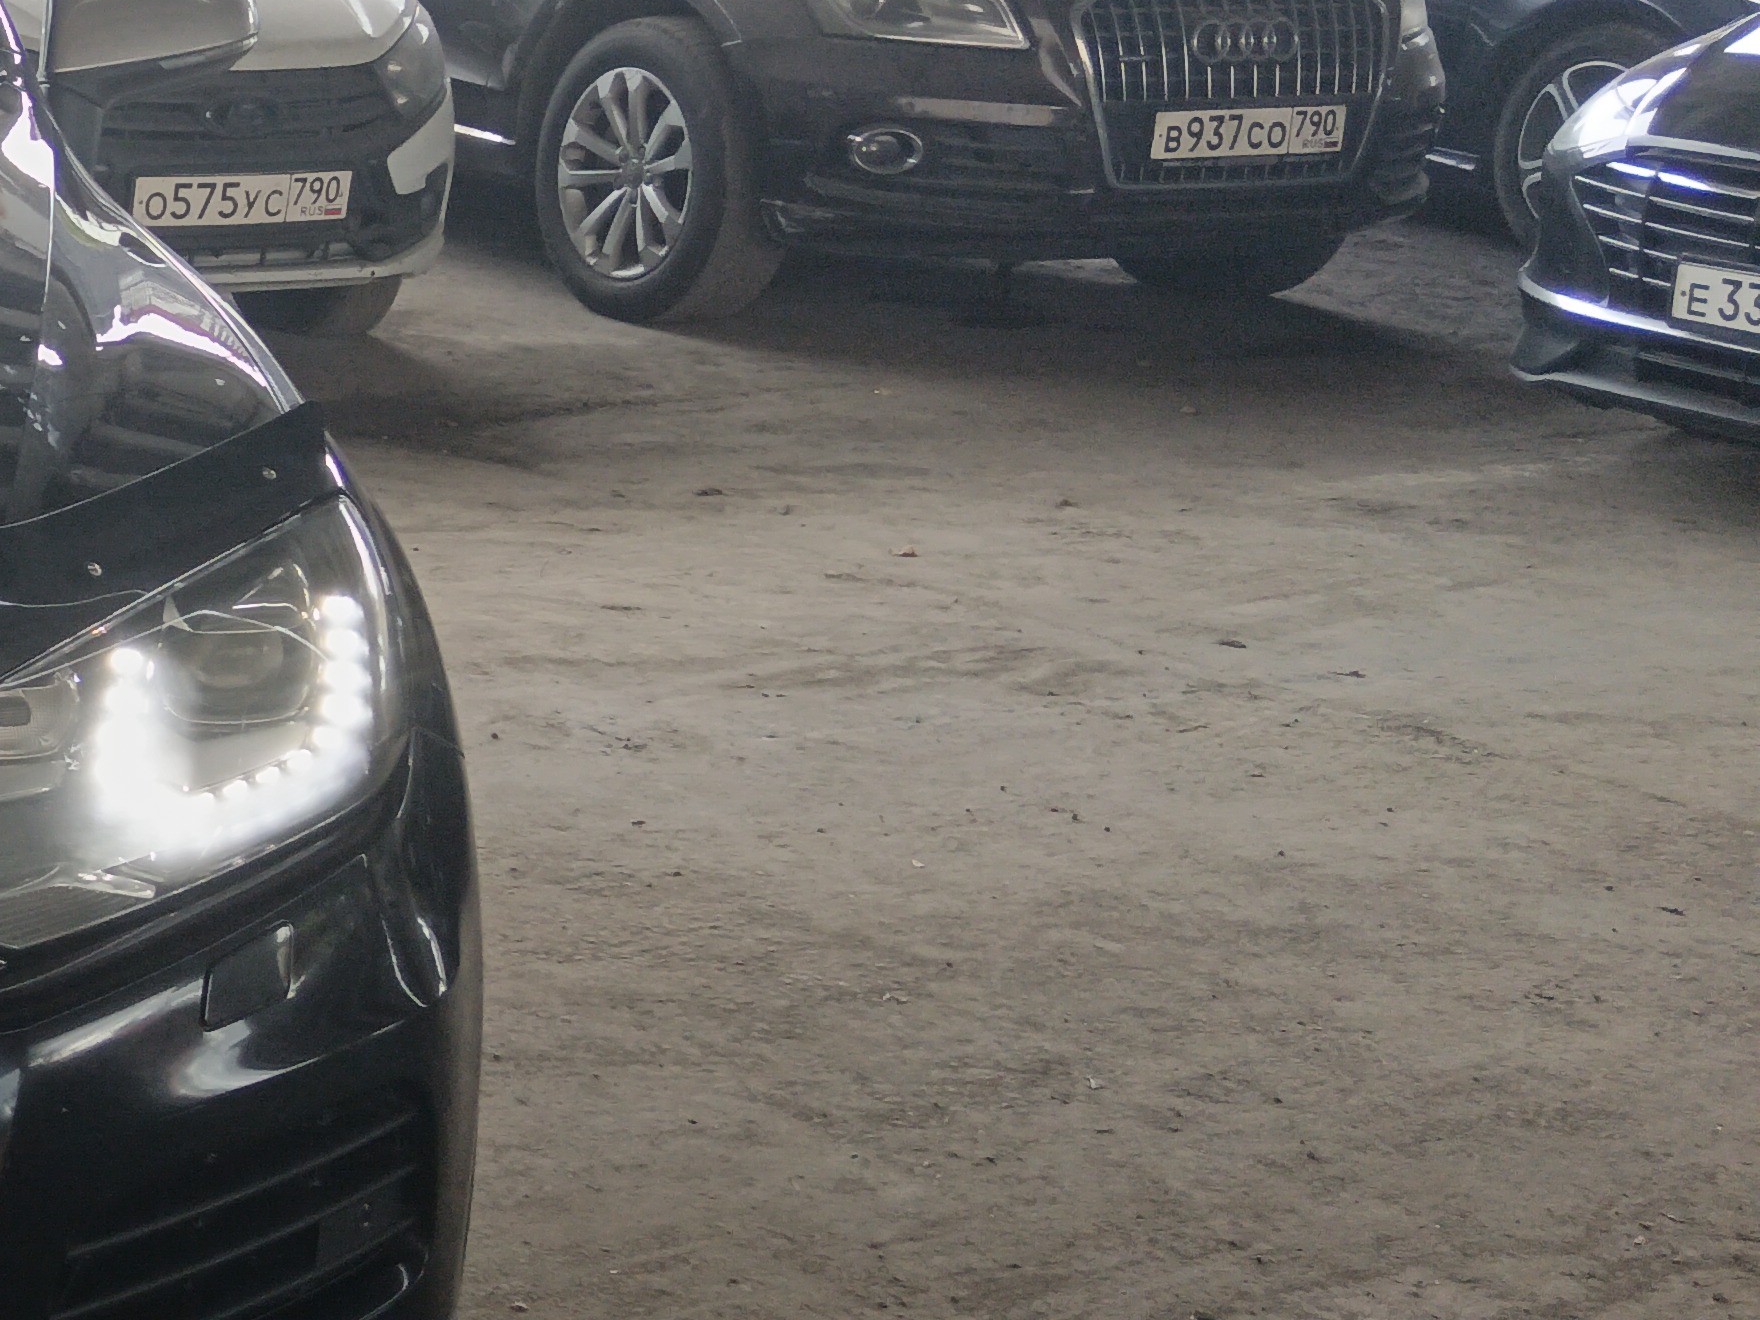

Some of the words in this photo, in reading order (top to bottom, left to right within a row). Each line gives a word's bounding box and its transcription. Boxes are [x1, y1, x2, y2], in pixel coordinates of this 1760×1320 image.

[1164, 113, 1287, 154] В937СО
[1295, 108, 1337, 138] 790
[1302, 138, 1324, 149] RUS
[144, 181, 284, 221] О575УС
[292, 175, 341, 207] 790
[299, 205, 324, 218] RUS
